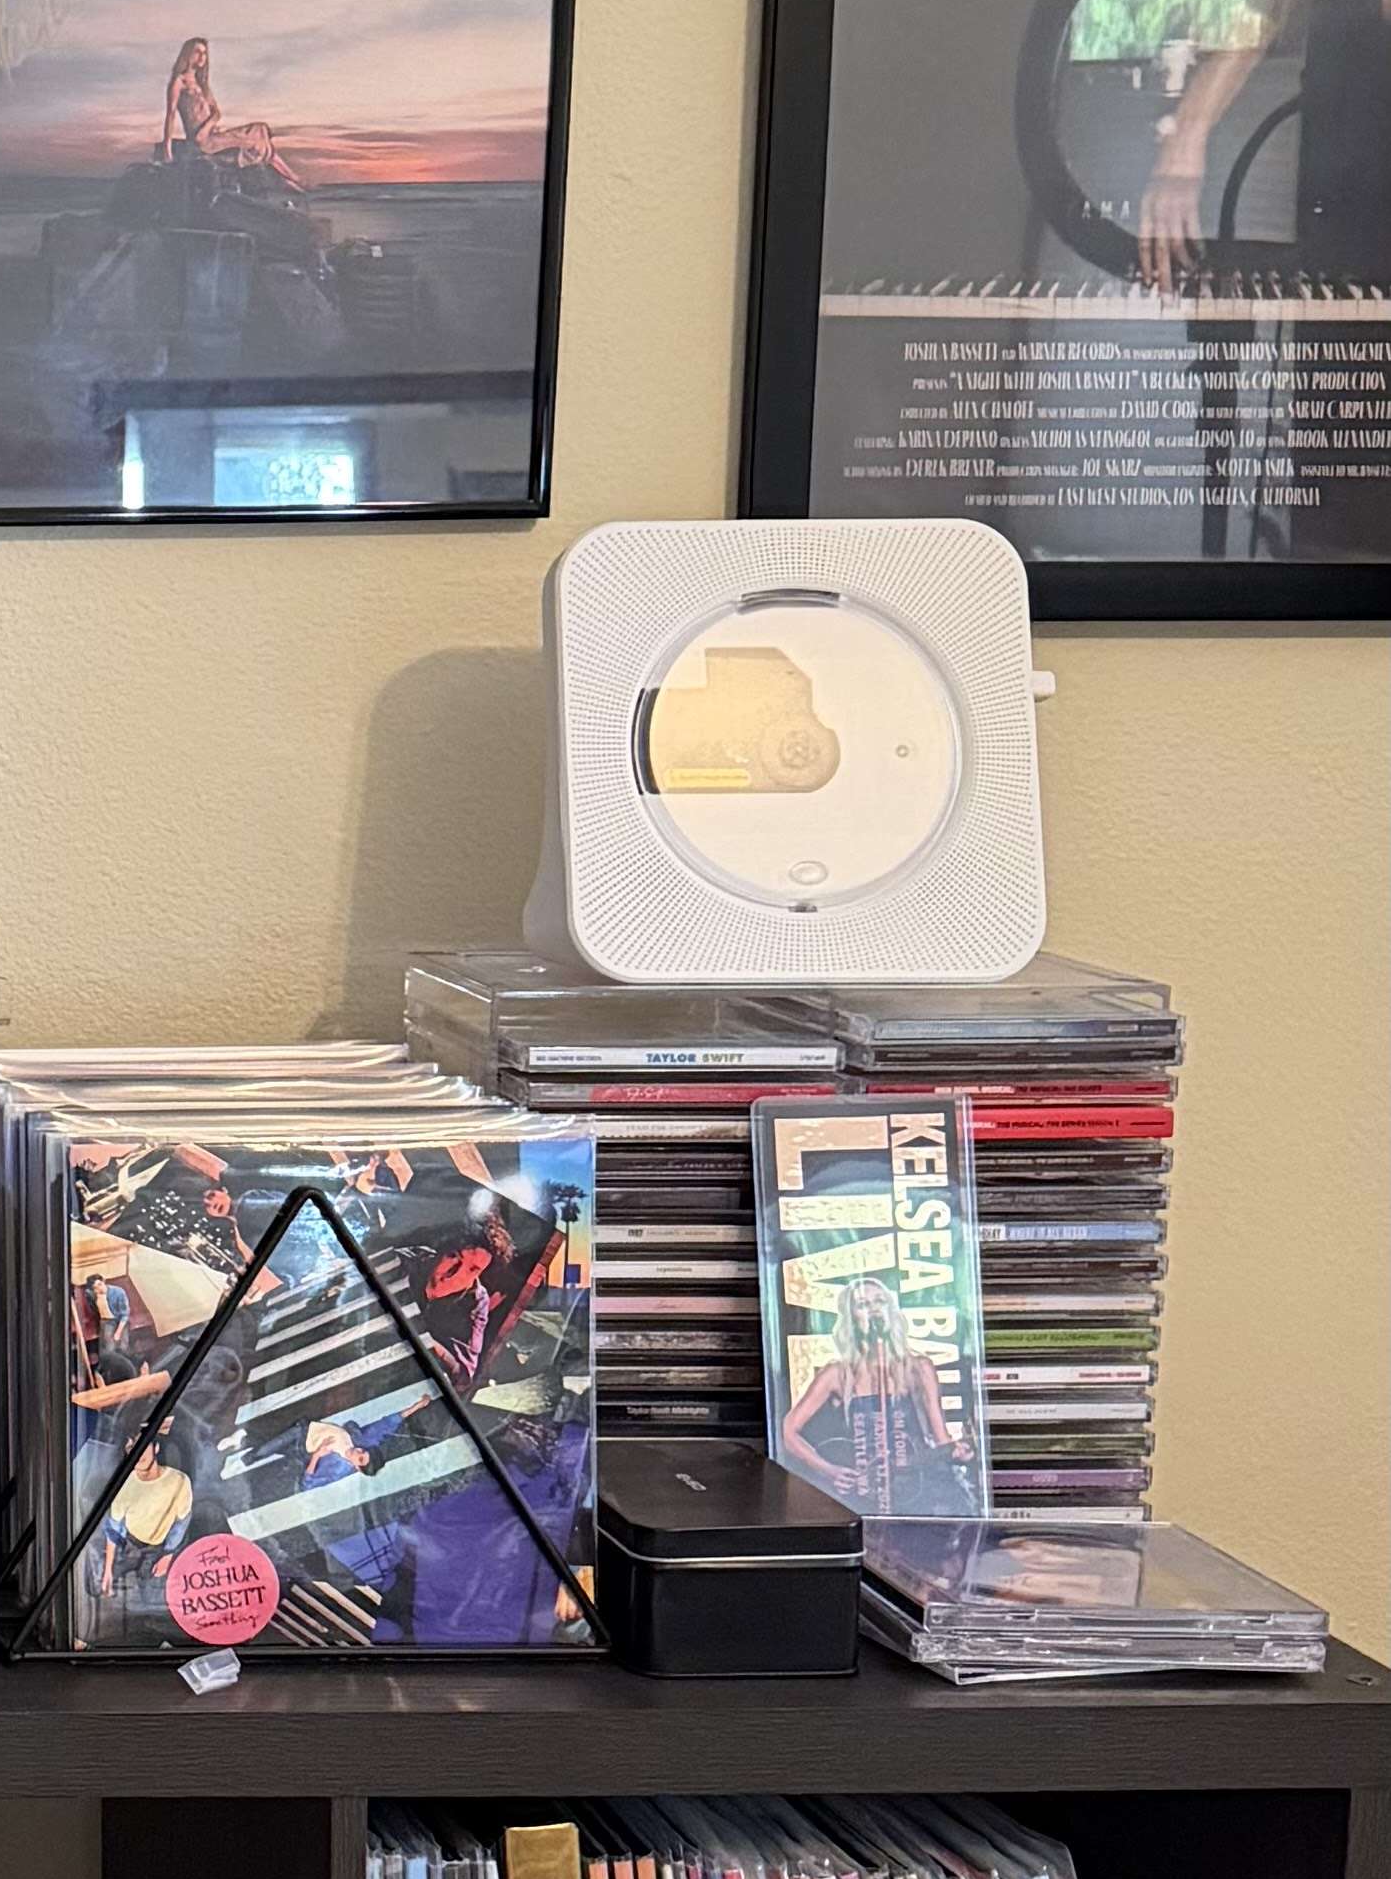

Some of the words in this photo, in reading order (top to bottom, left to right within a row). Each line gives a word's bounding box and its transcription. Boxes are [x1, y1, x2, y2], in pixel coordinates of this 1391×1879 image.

[645, 1052, 696, 1063] TAYLOR
[702, 1052, 745, 1063] SWIFT
[890, 1113, 954, 1293] KELSEA
[182, 1564, 260, 1594] JOSHUA
[181, 1585, 267, 1616] BASSETT
